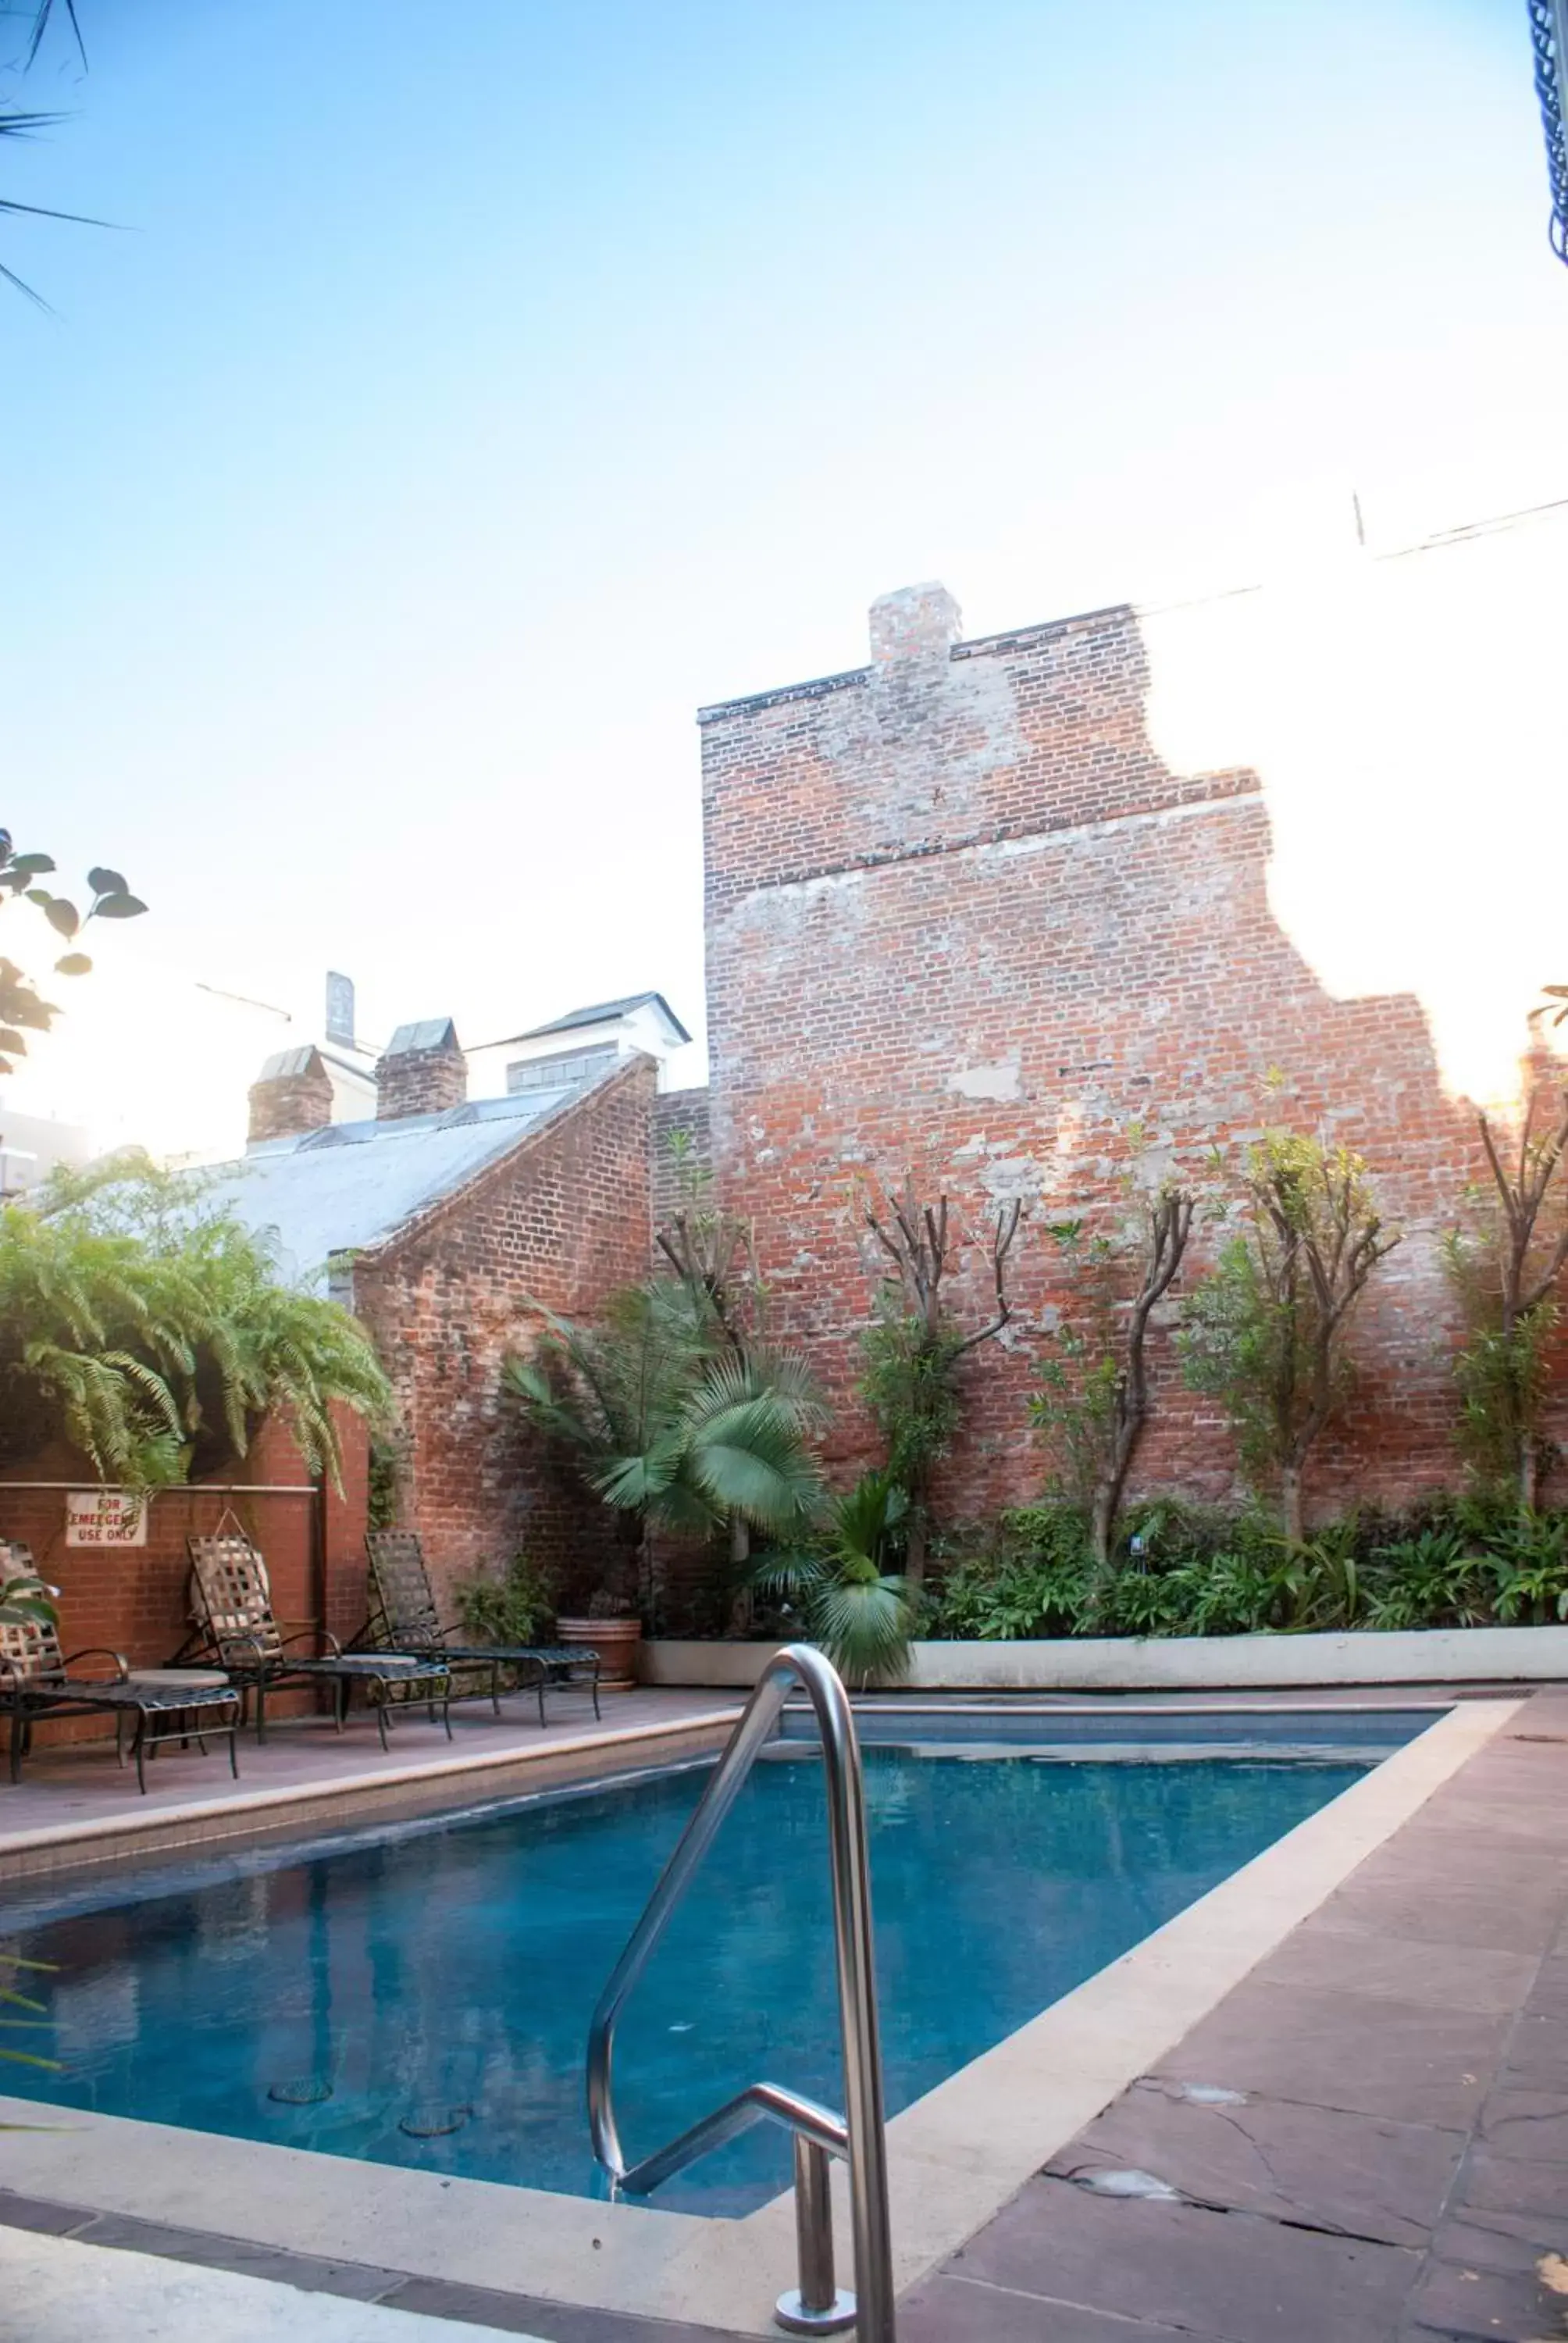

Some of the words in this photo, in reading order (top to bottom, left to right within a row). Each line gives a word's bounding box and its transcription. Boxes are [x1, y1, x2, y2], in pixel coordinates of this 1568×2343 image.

[98, 1499, 120, 1510] FOR
[79, 1529, 102, 1540] USE
[108, 1529, 136, 1540] ONLY
